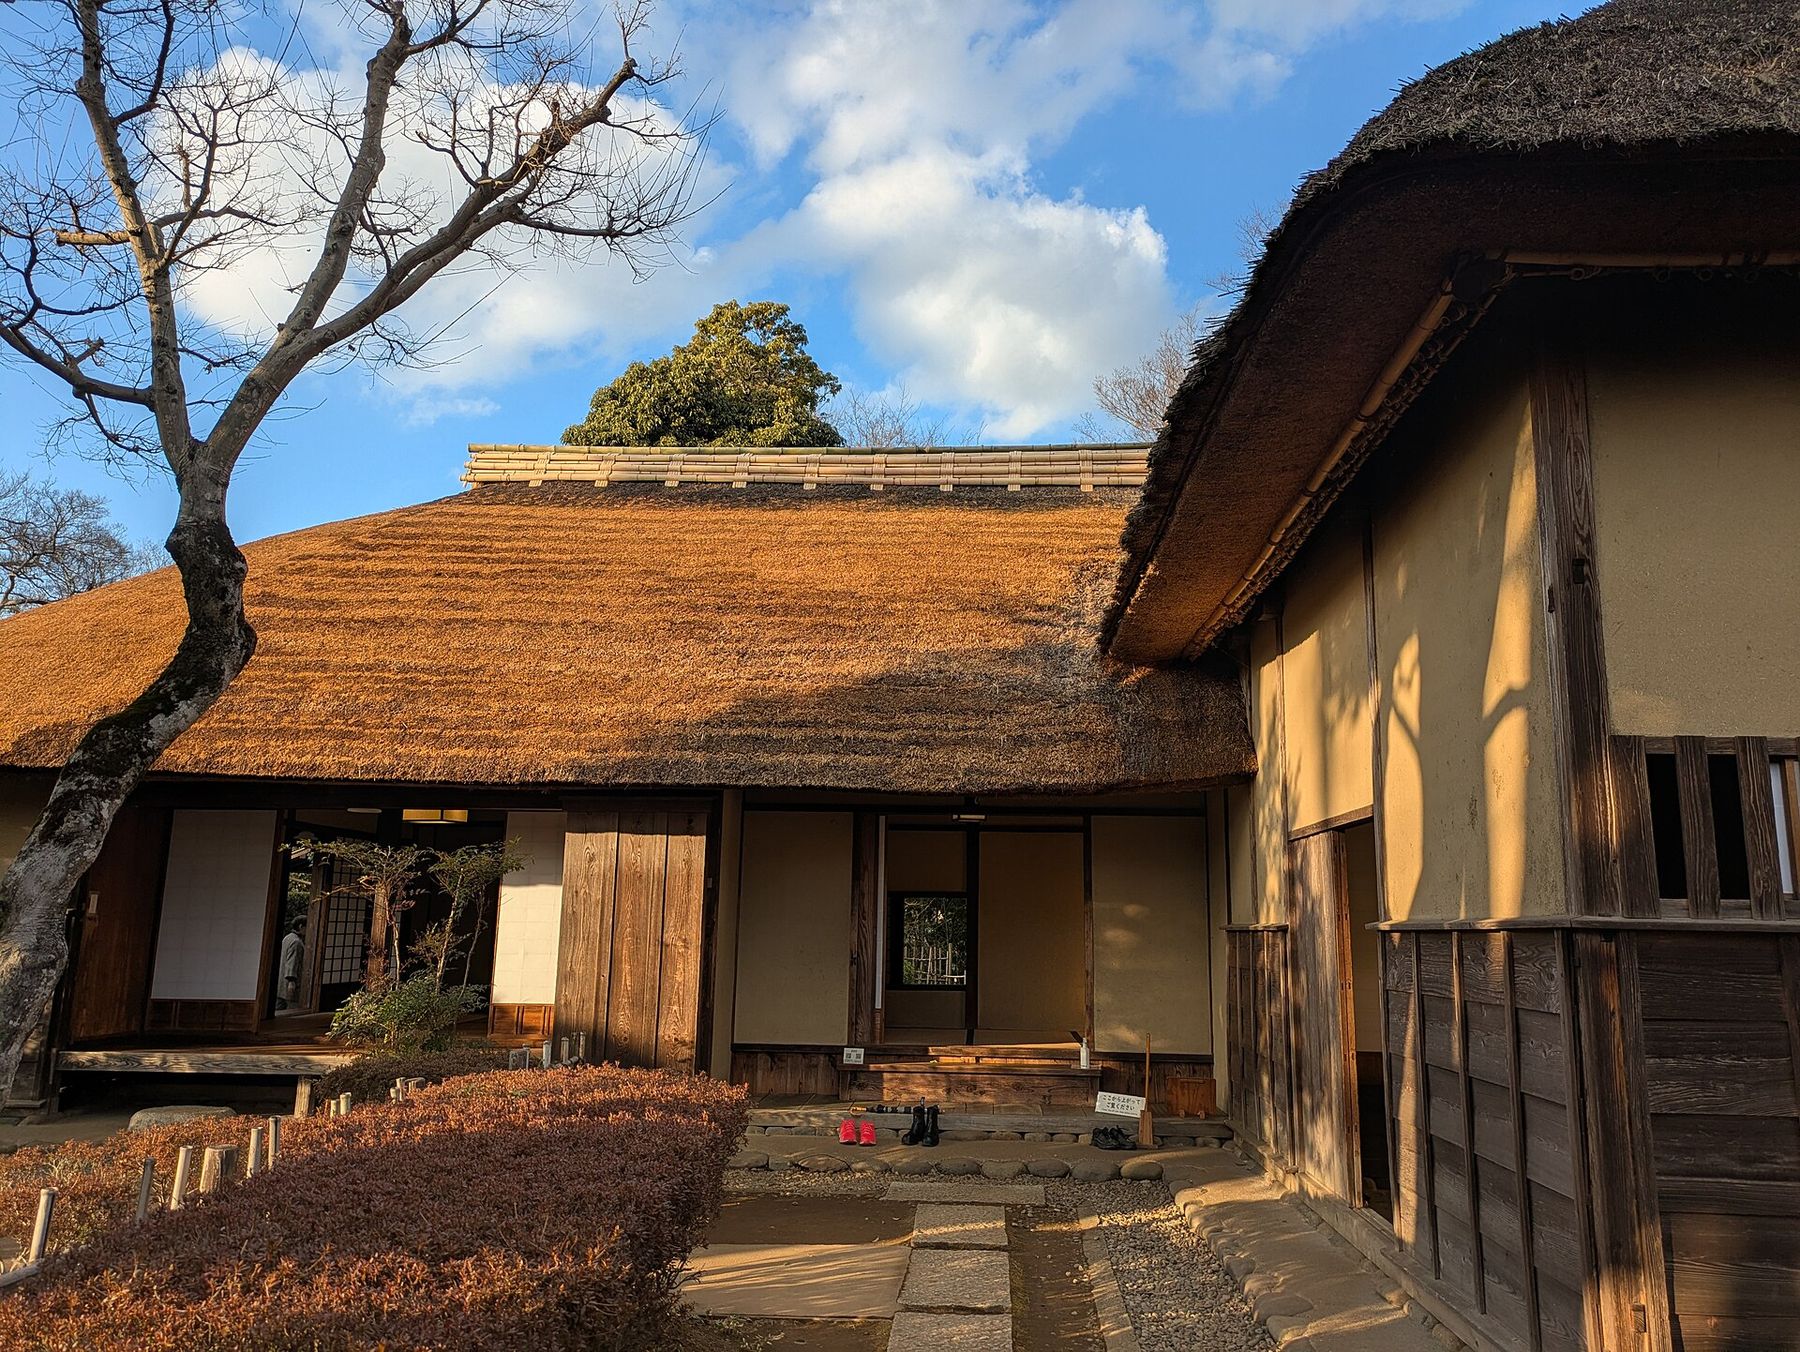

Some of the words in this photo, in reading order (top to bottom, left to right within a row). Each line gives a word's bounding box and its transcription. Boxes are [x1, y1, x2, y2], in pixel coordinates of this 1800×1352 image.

[1103, 1095, 1141, 1105] ここから上がって
[1106, 1102, 1135, 1111] ご覧ください
